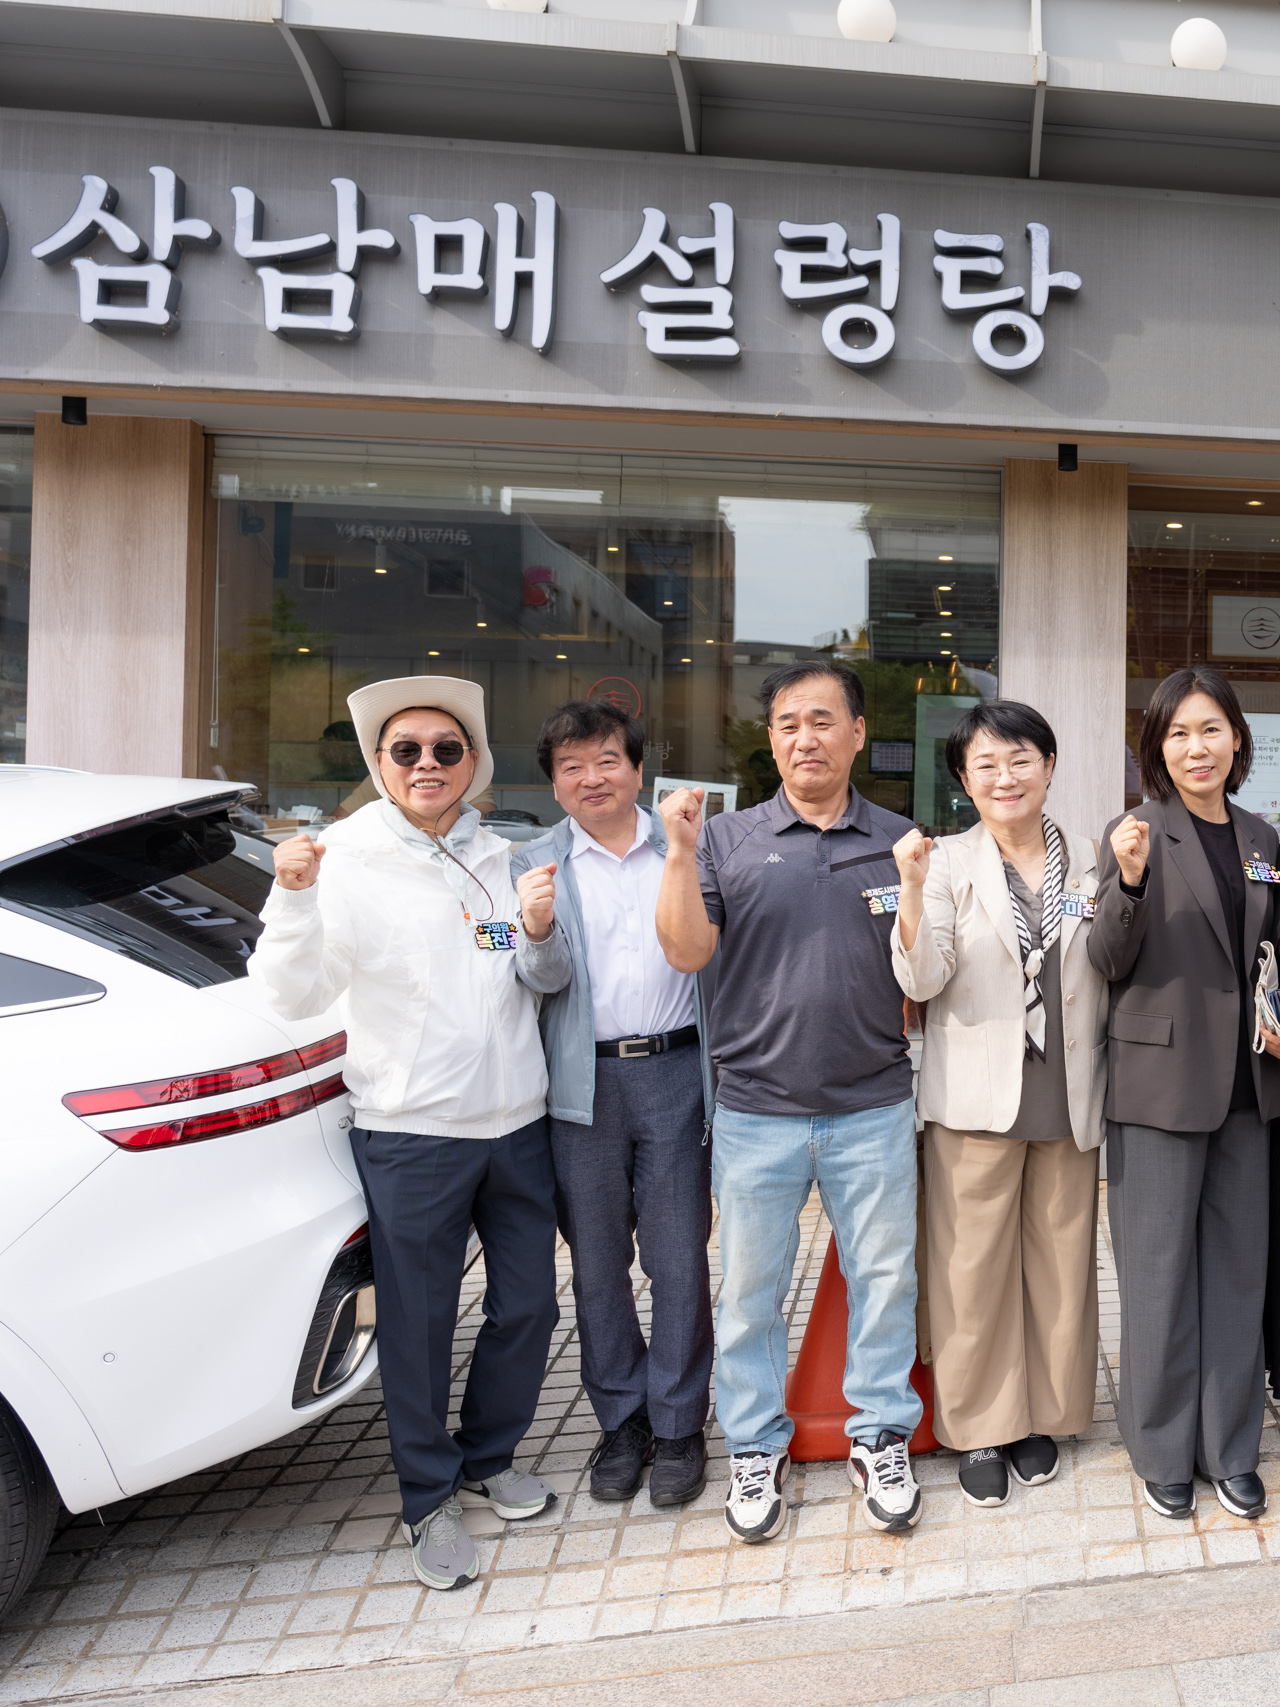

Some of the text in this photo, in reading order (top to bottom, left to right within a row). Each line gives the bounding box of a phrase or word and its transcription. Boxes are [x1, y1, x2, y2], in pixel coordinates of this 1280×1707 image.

[31, 166, 1082, 376] 삼남매 설렁탕
[1060, 892, 1088, 904] 구의원
[483, 922, 511, 933] 구의원
[969, 1447, 998, 1465] FILA
